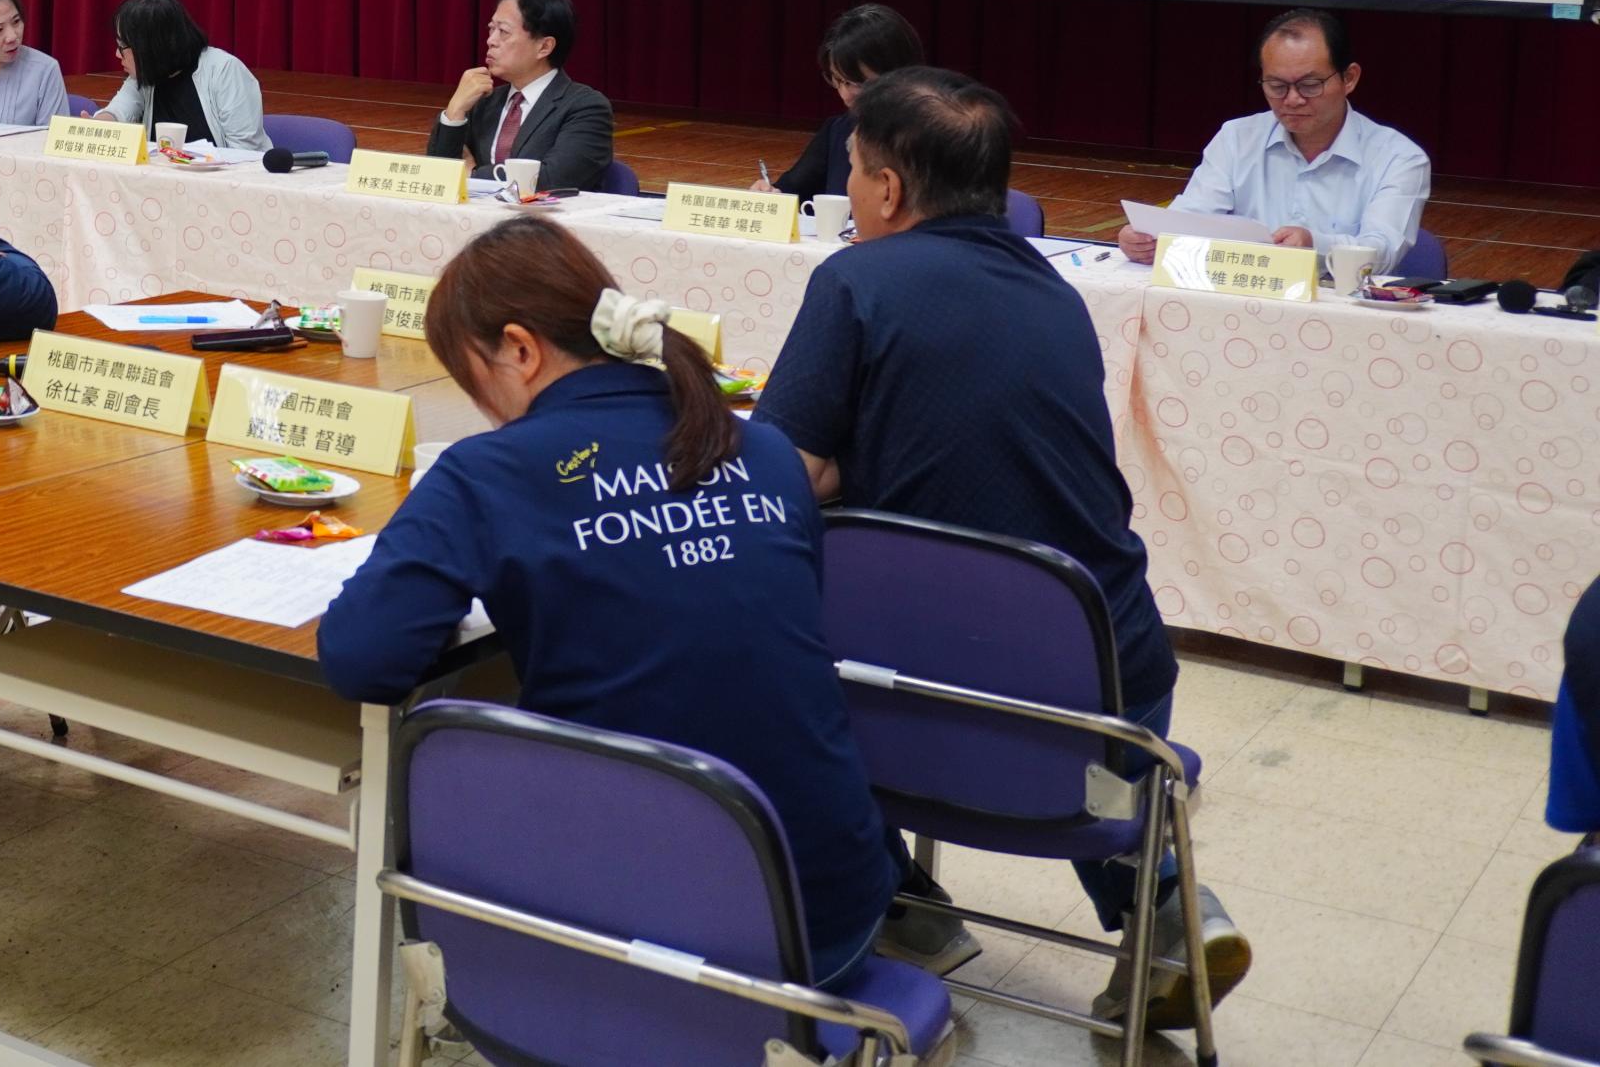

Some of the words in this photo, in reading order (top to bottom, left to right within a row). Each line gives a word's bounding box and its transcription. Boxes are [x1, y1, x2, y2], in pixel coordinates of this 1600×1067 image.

[388, 162, 421, 175] 農業部
[681, 193, 778, 215] 桃園區農業改良場
[734, 218, 762, 234] 場長
[1231, 272, 1285, 292] 總幹事
[47, 349, 176, 390] 桃園市青農聯誼會
[45, 378, 100, 408] 徐仕豪
[103, 389, 161, 420] 副會長
[314, 428, 357, 457] 督導
[592, 457, 750, 502] MAION
[573, 490, 736, 551] FONDÉE
[741, 493, 787, 524] EN
[661, 534, 735, 569] 1882
